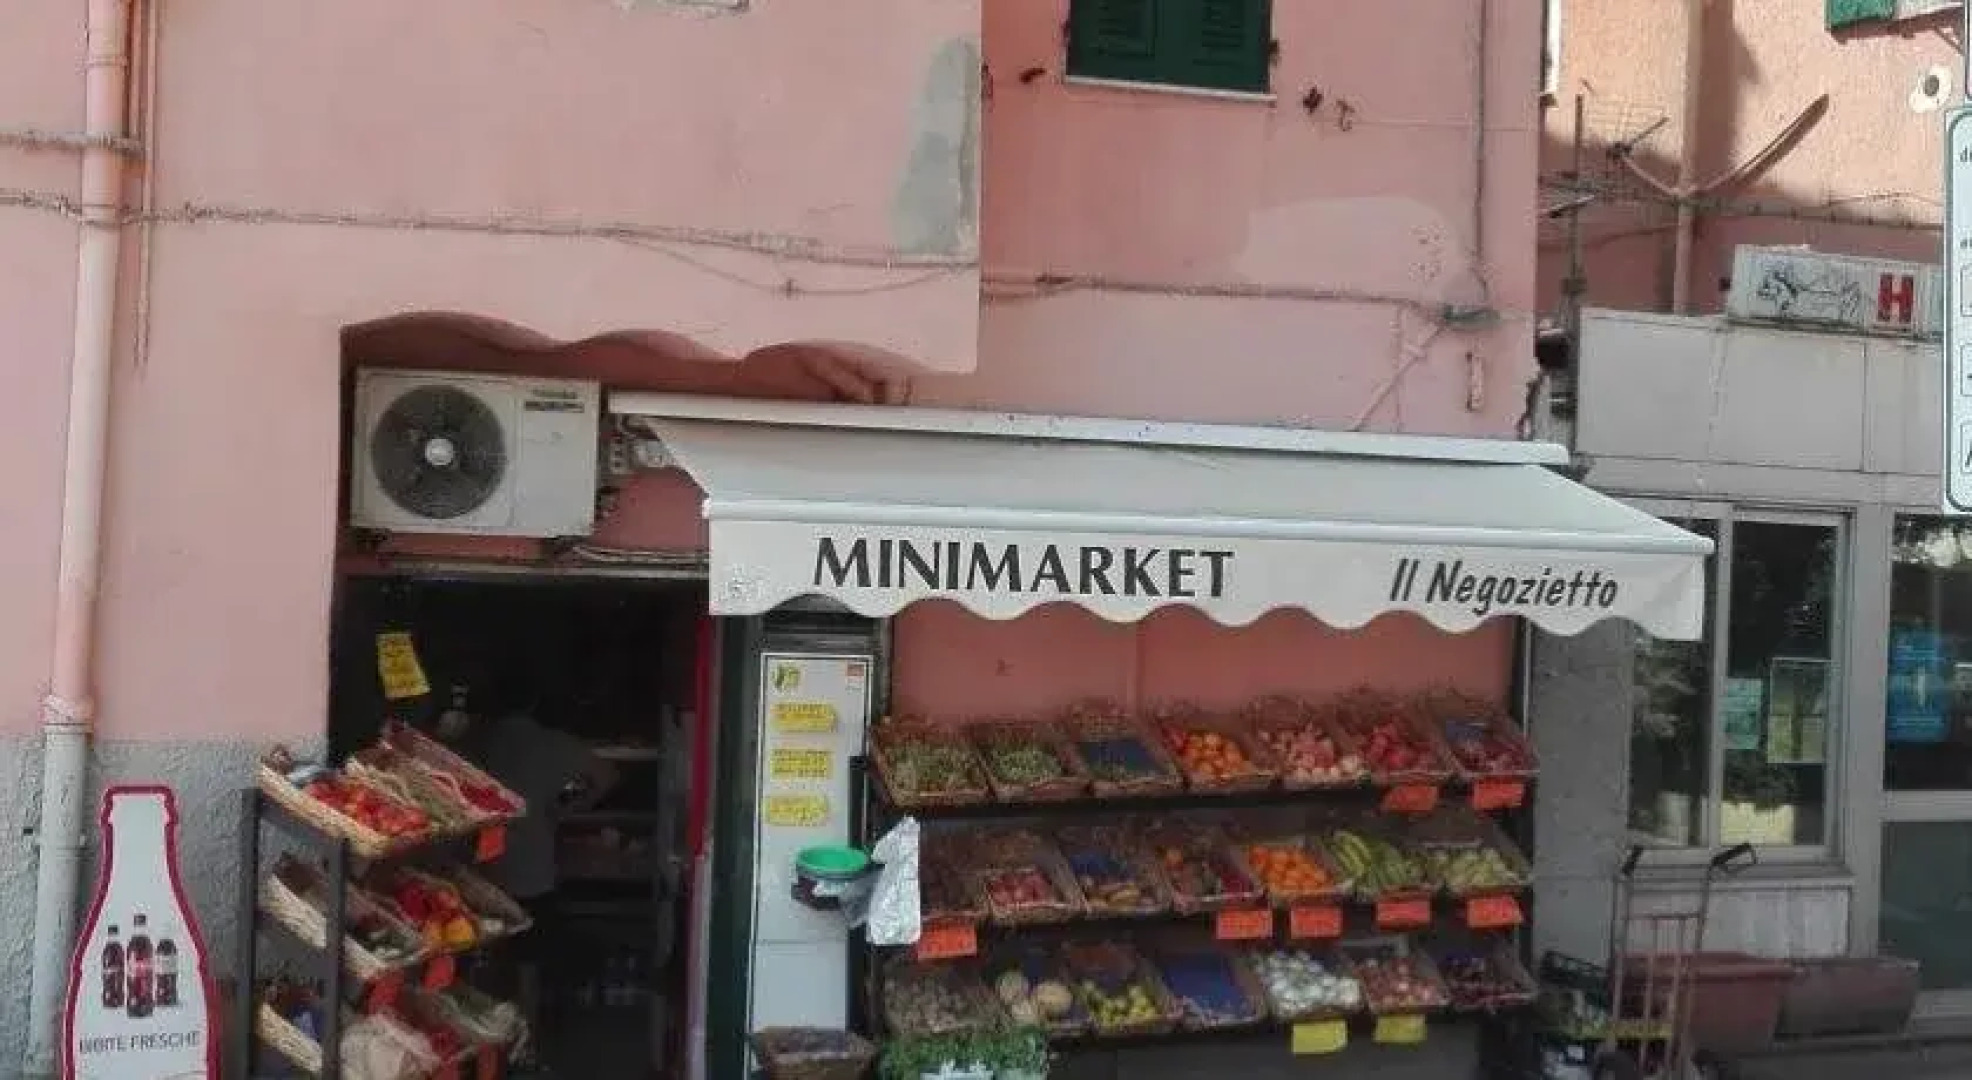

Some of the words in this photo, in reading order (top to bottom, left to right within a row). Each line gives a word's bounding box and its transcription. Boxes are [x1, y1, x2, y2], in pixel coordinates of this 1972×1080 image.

[1878, 273, 1914, 323] H
[813, 537, 1235, 597] MINIMARKET
[1390, 558, 1420, 601] Il
[1425, 560, 1618, 616] Negozietto
[131, 1030, 201, 1051] FRESCHE
